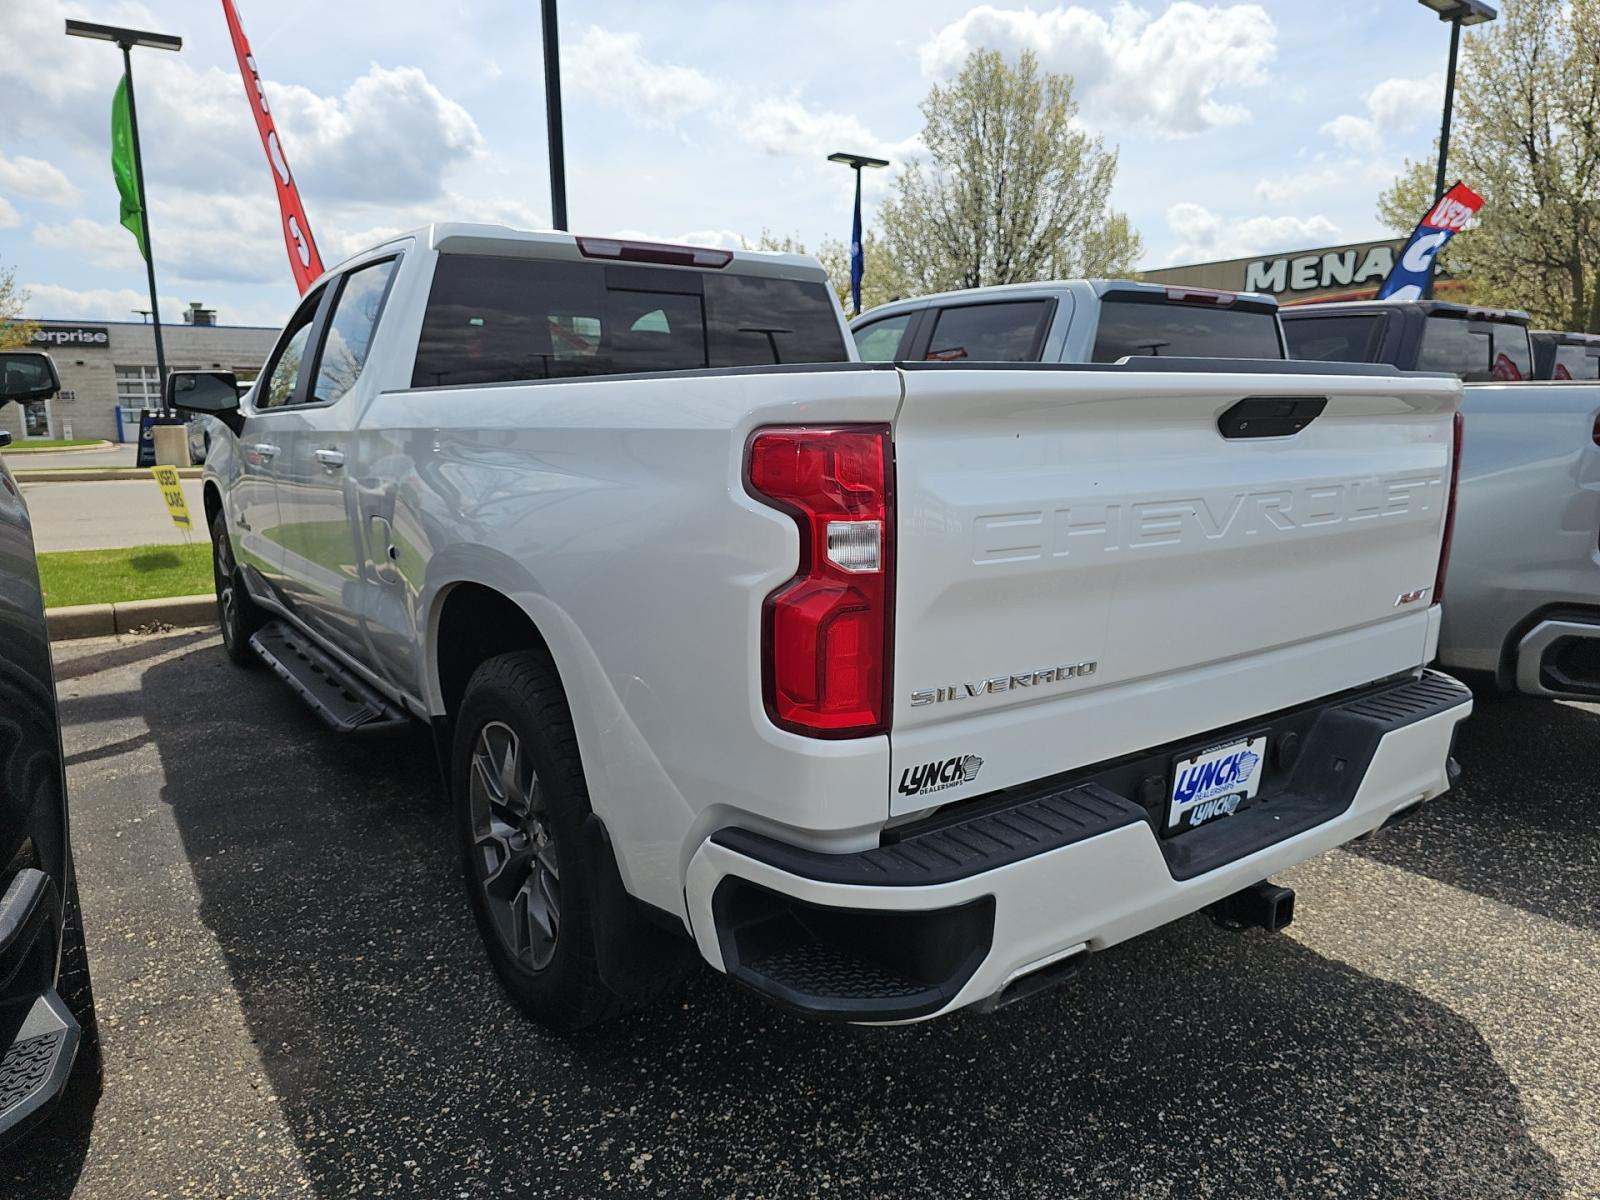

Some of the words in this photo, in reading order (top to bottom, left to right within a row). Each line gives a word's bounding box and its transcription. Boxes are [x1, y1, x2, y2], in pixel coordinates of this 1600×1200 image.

[1244, 246, 1395, 293] MENA
[34, 329, 107, 344] erprise
[972, 474, 1441, 566] CHEVROLET
[910, 661, 1098, 708] SILVERADO
[898, 755, 969, 796] LYNCH
[919, 780, 964, 796] DEALERSHIPS
[1174, 751, 1243, 804] LYNCH
